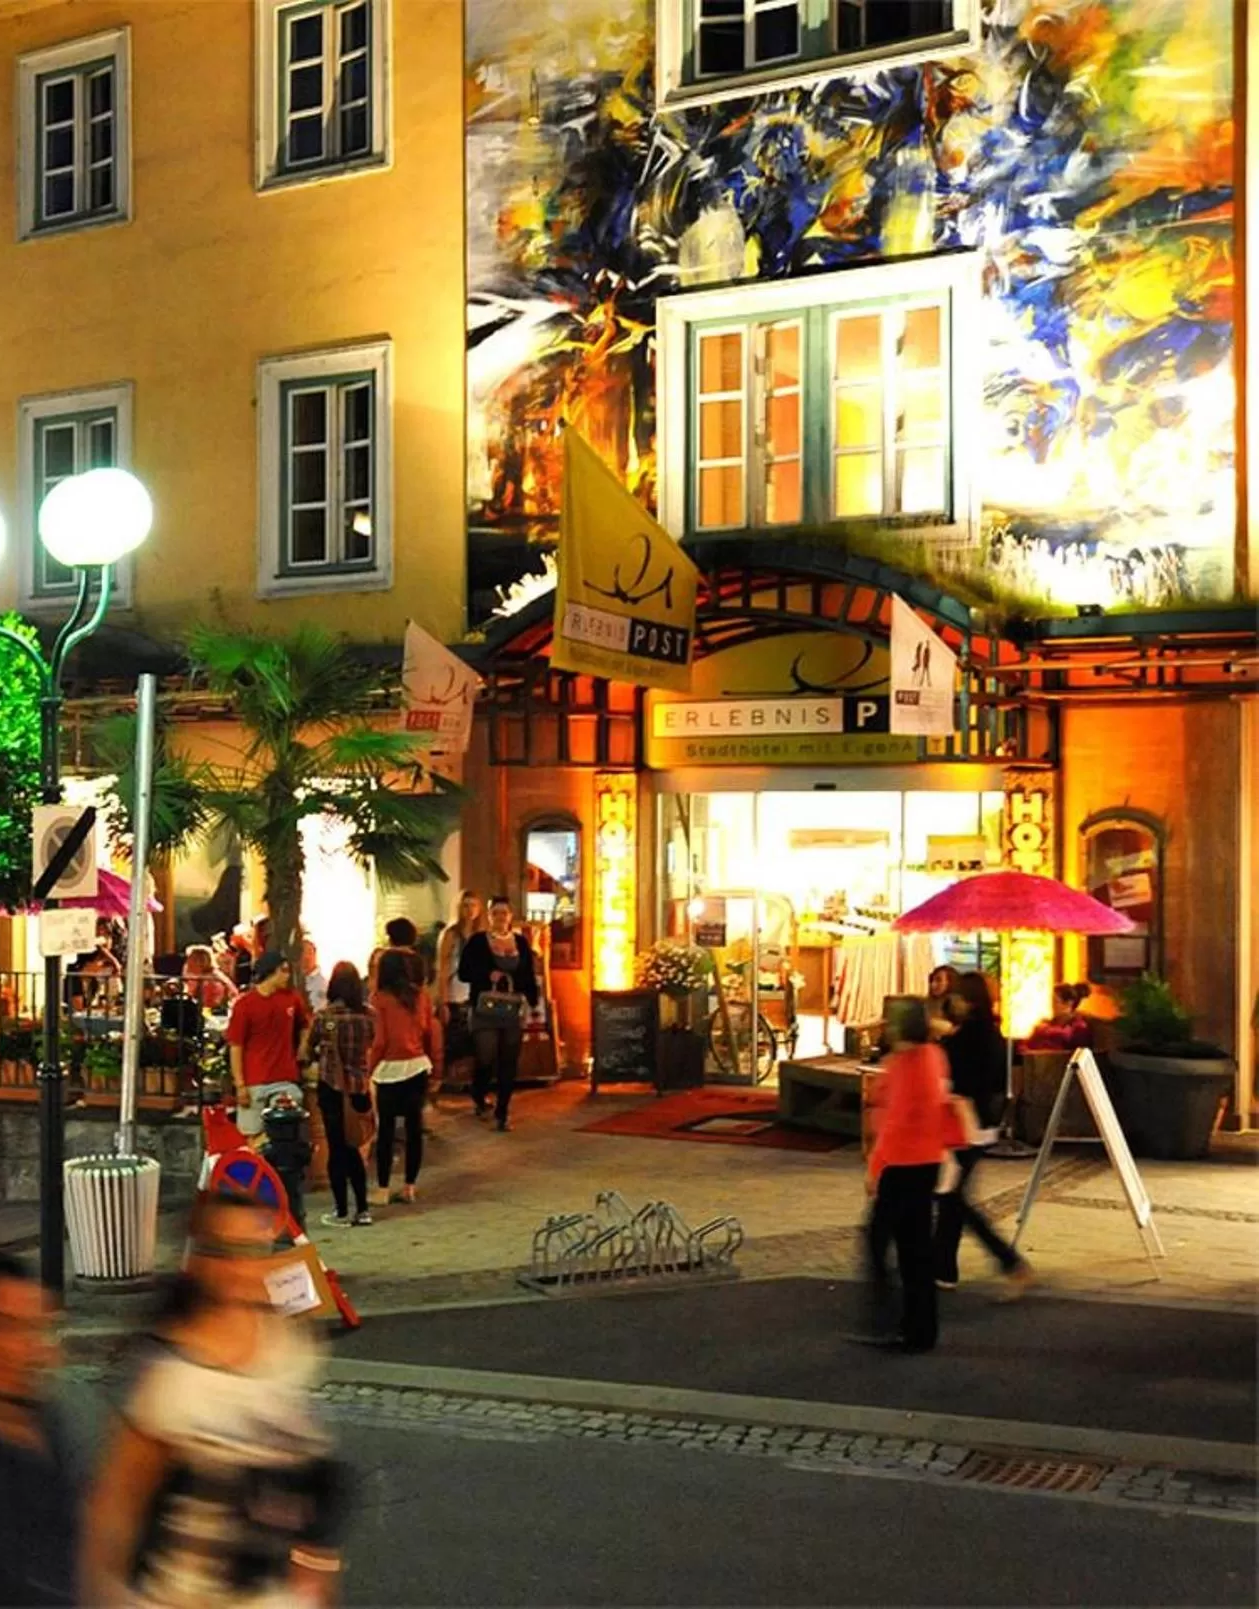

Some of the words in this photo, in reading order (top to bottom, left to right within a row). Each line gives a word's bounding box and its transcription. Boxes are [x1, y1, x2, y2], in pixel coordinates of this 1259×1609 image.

[633, 624, 686, 657] POST
[664, 706, 831, 729] ERLEBNIS
[1010, 791, 1044, 874] HOT
